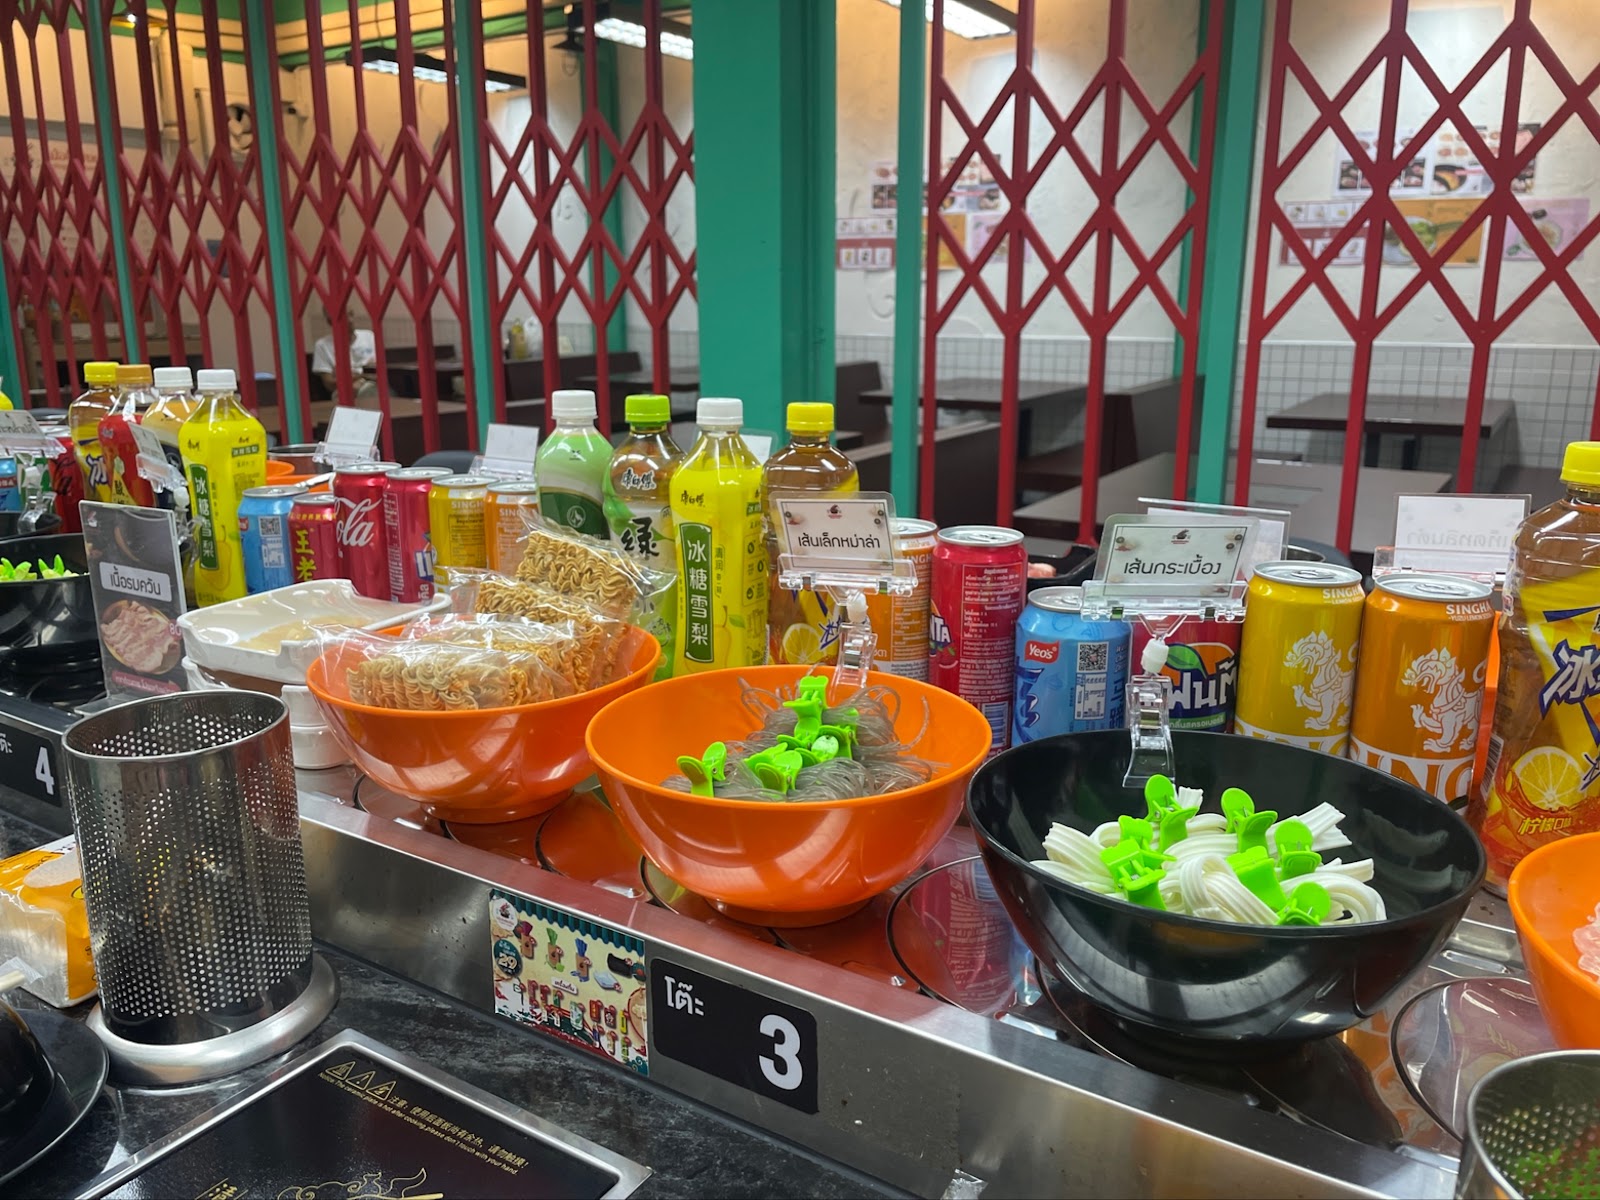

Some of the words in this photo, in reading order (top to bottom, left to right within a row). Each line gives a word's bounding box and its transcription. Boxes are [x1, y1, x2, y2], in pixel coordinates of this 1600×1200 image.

[798, 532, 881, 549] เส้นเล็กหม่าล่า
[109, 566, 161, 596] เนื้อรมควัน
[1123, 554, 1222, 575] เส้นกระเบื้อง
[687, 539, 708, 646] 冰糖雪梨
[1029, 643, 1054, 660] Yeo's
[35, 746, 55, 796] 4
[663, 975, 706, 1017] โต๊ะ
[758, 1014, 804, 1092] 3
